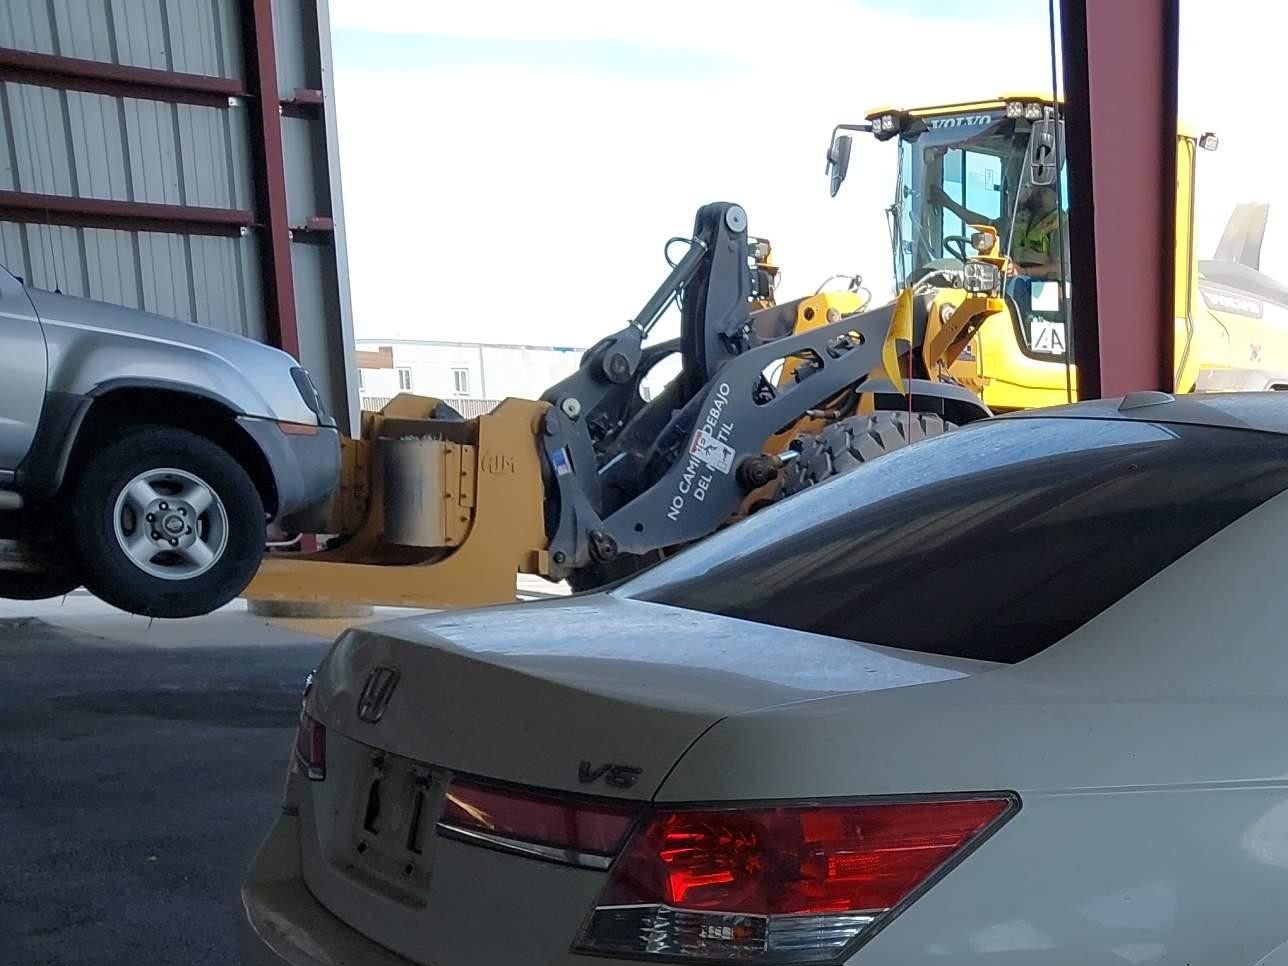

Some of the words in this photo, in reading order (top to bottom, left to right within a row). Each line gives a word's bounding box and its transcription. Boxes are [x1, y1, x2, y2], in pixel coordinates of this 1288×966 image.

[667, 495, 684, 521] NO
[702, 382, 730, 437] DEBAJO
[693, 474, 713, 501] DEL
[578, 760, 643, 790] V6
